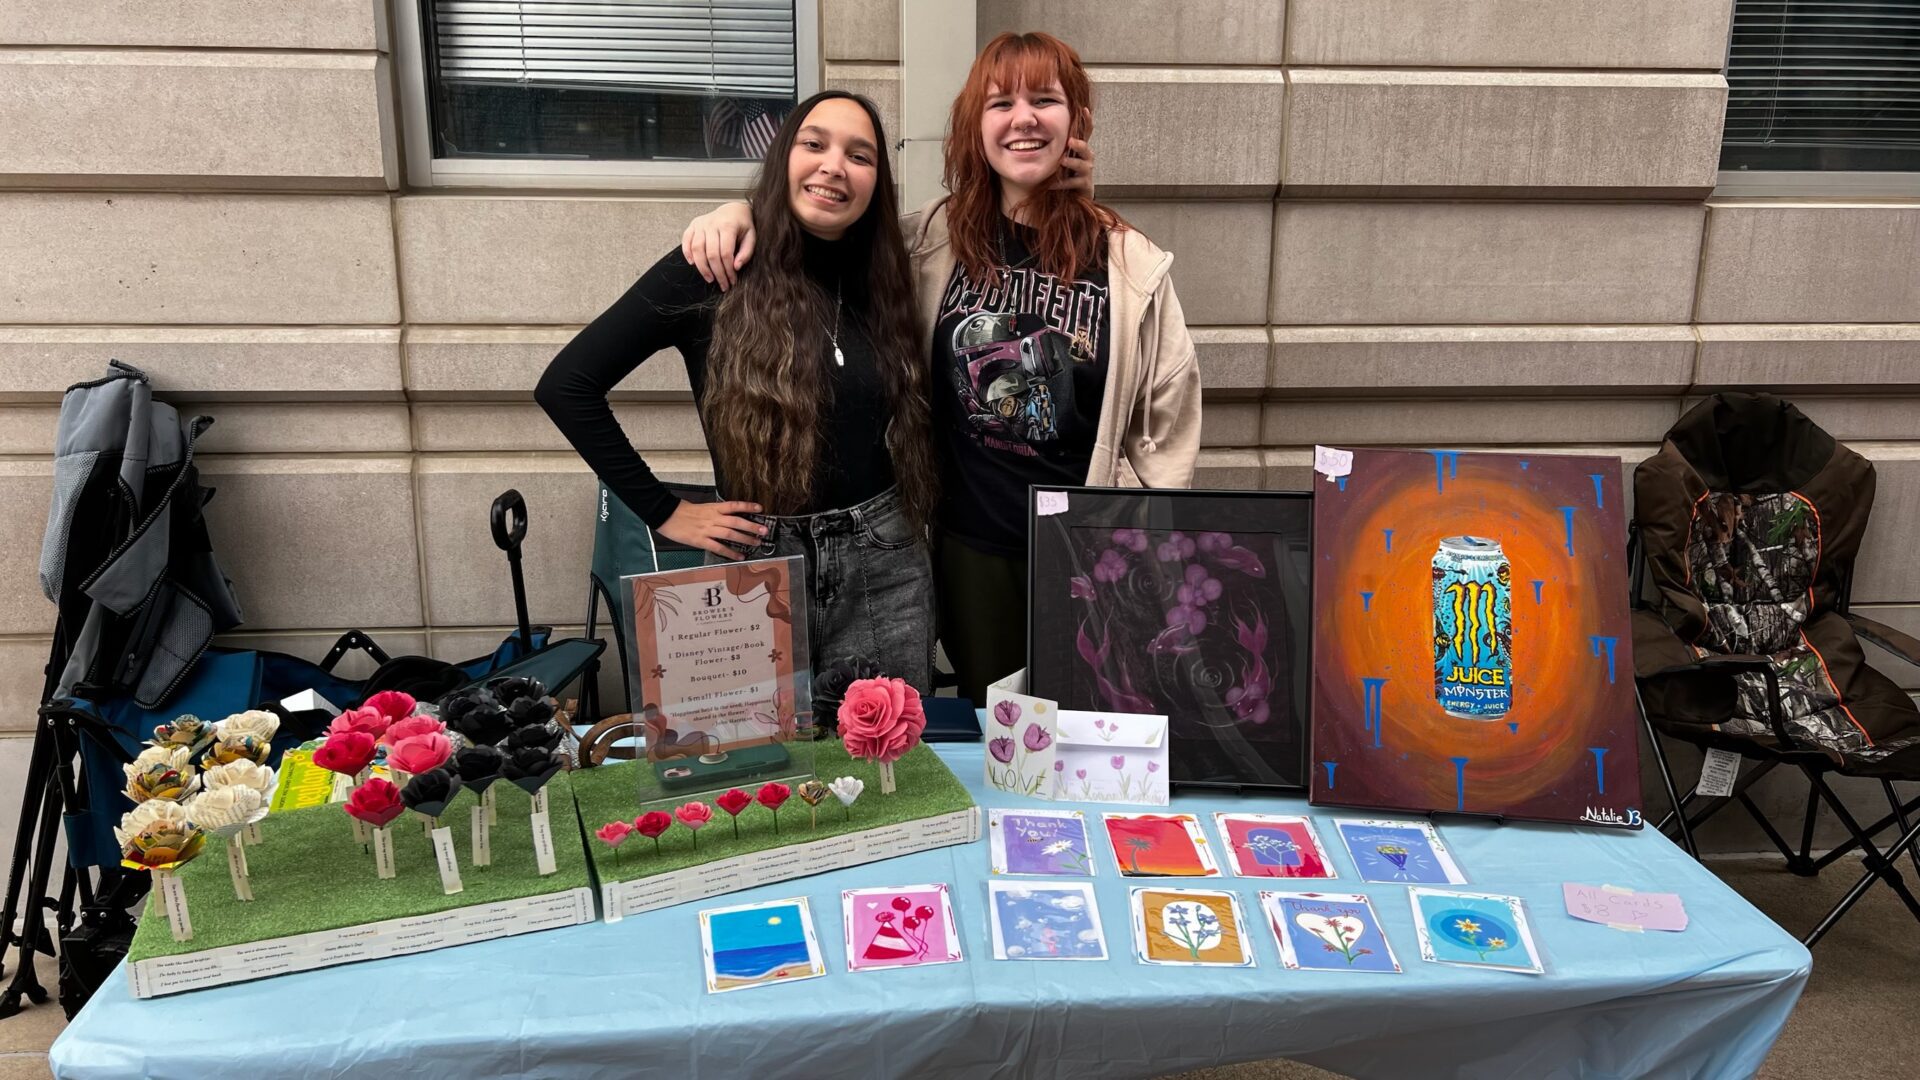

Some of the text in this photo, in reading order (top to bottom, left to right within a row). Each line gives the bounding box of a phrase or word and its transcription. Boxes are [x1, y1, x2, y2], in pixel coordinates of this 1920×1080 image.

[692, 606, 735, 616] BROWER'S
[695, 613, 734, 622] FLOWERS
[677, 631, 711, 641] Regular
[750, 623, 760, 632] $2
[675, 649, 705, 659] Disney
[707, 640, 765, 655] Vintage/Book
[730, 653, 741, 661] $3
[732, 668, 747, 677] $10
[1446, 664, 1505, 686] JUICE
[687, 693, 712, 703] Small
[750, 686, 759, 694] $1
[1443, 683, 1510, 700] MONSTER
[1446, 699, 1505, 710] ENERGY JUICE
[693, 714, 711, 722] shared
[992, 766, 1047, 797] LOVE
[1580, 806, 1626, 825] Natalie
[1011, 817, 1067, 829] Thank
[1576, 889, 1597, 899] All
